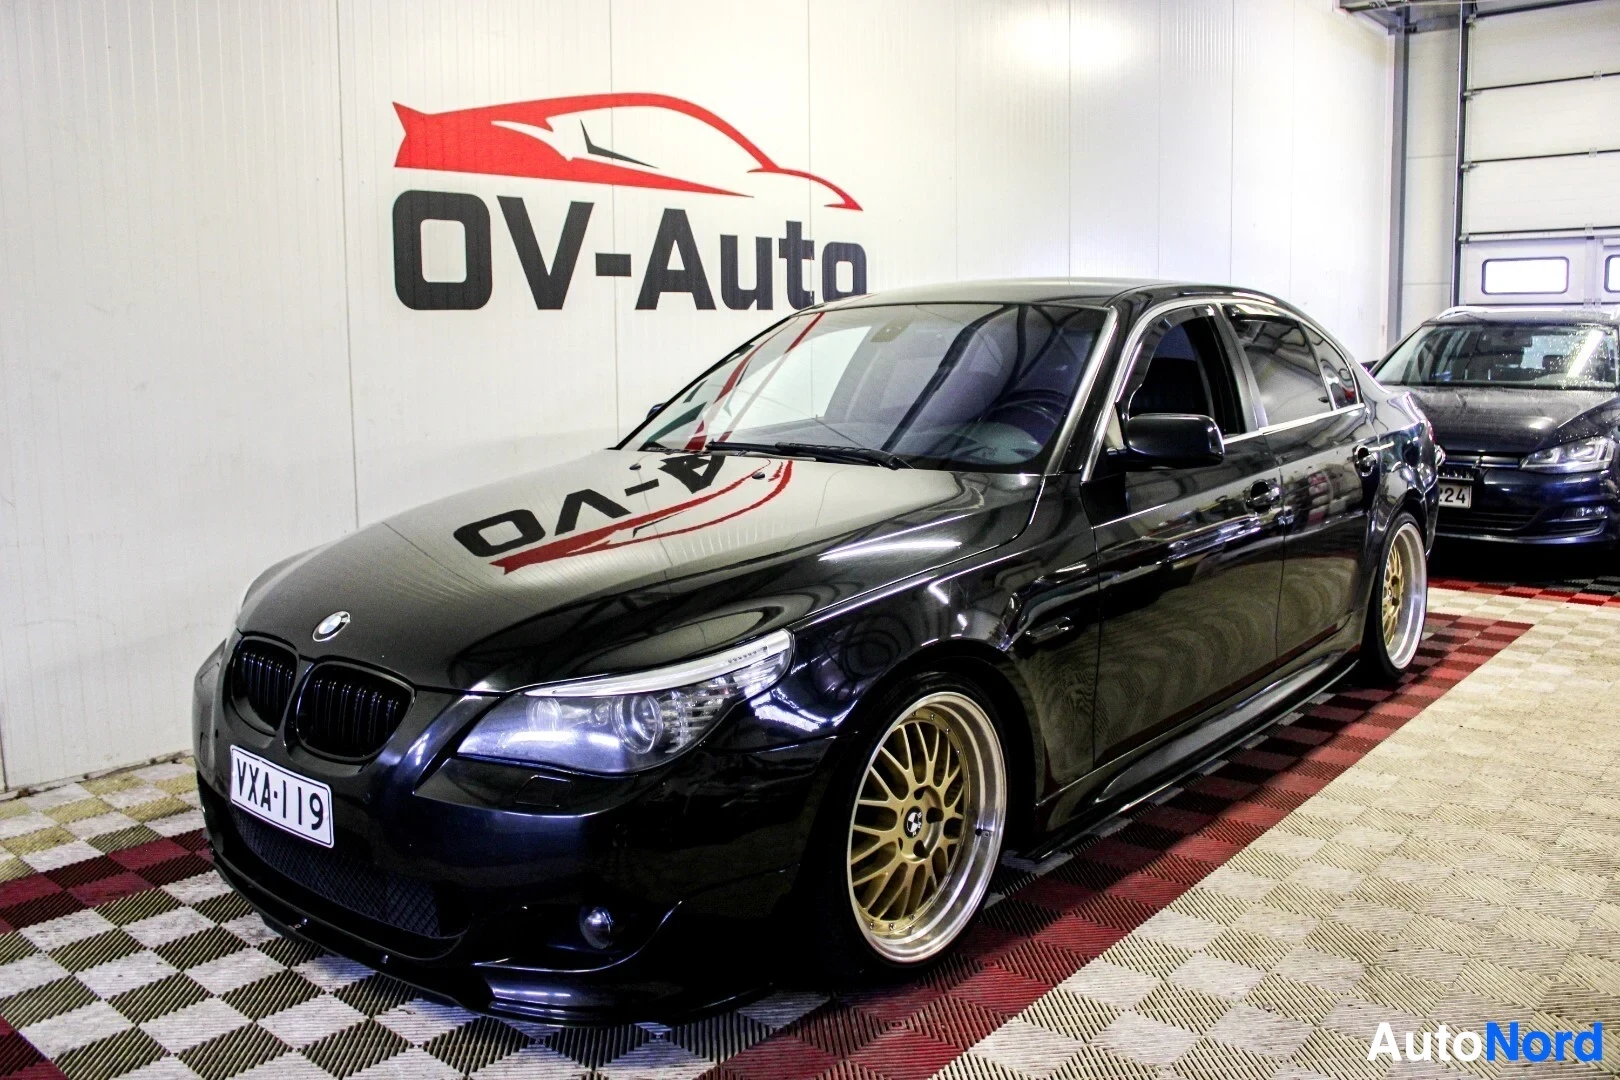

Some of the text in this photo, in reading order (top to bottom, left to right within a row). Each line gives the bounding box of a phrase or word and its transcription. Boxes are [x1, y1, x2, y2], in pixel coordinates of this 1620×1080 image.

[392, 189, 867, 311] OV-Auto
[1438, 487, 1466, 504] 24
[236, 757, 325, 831] VXA-119
